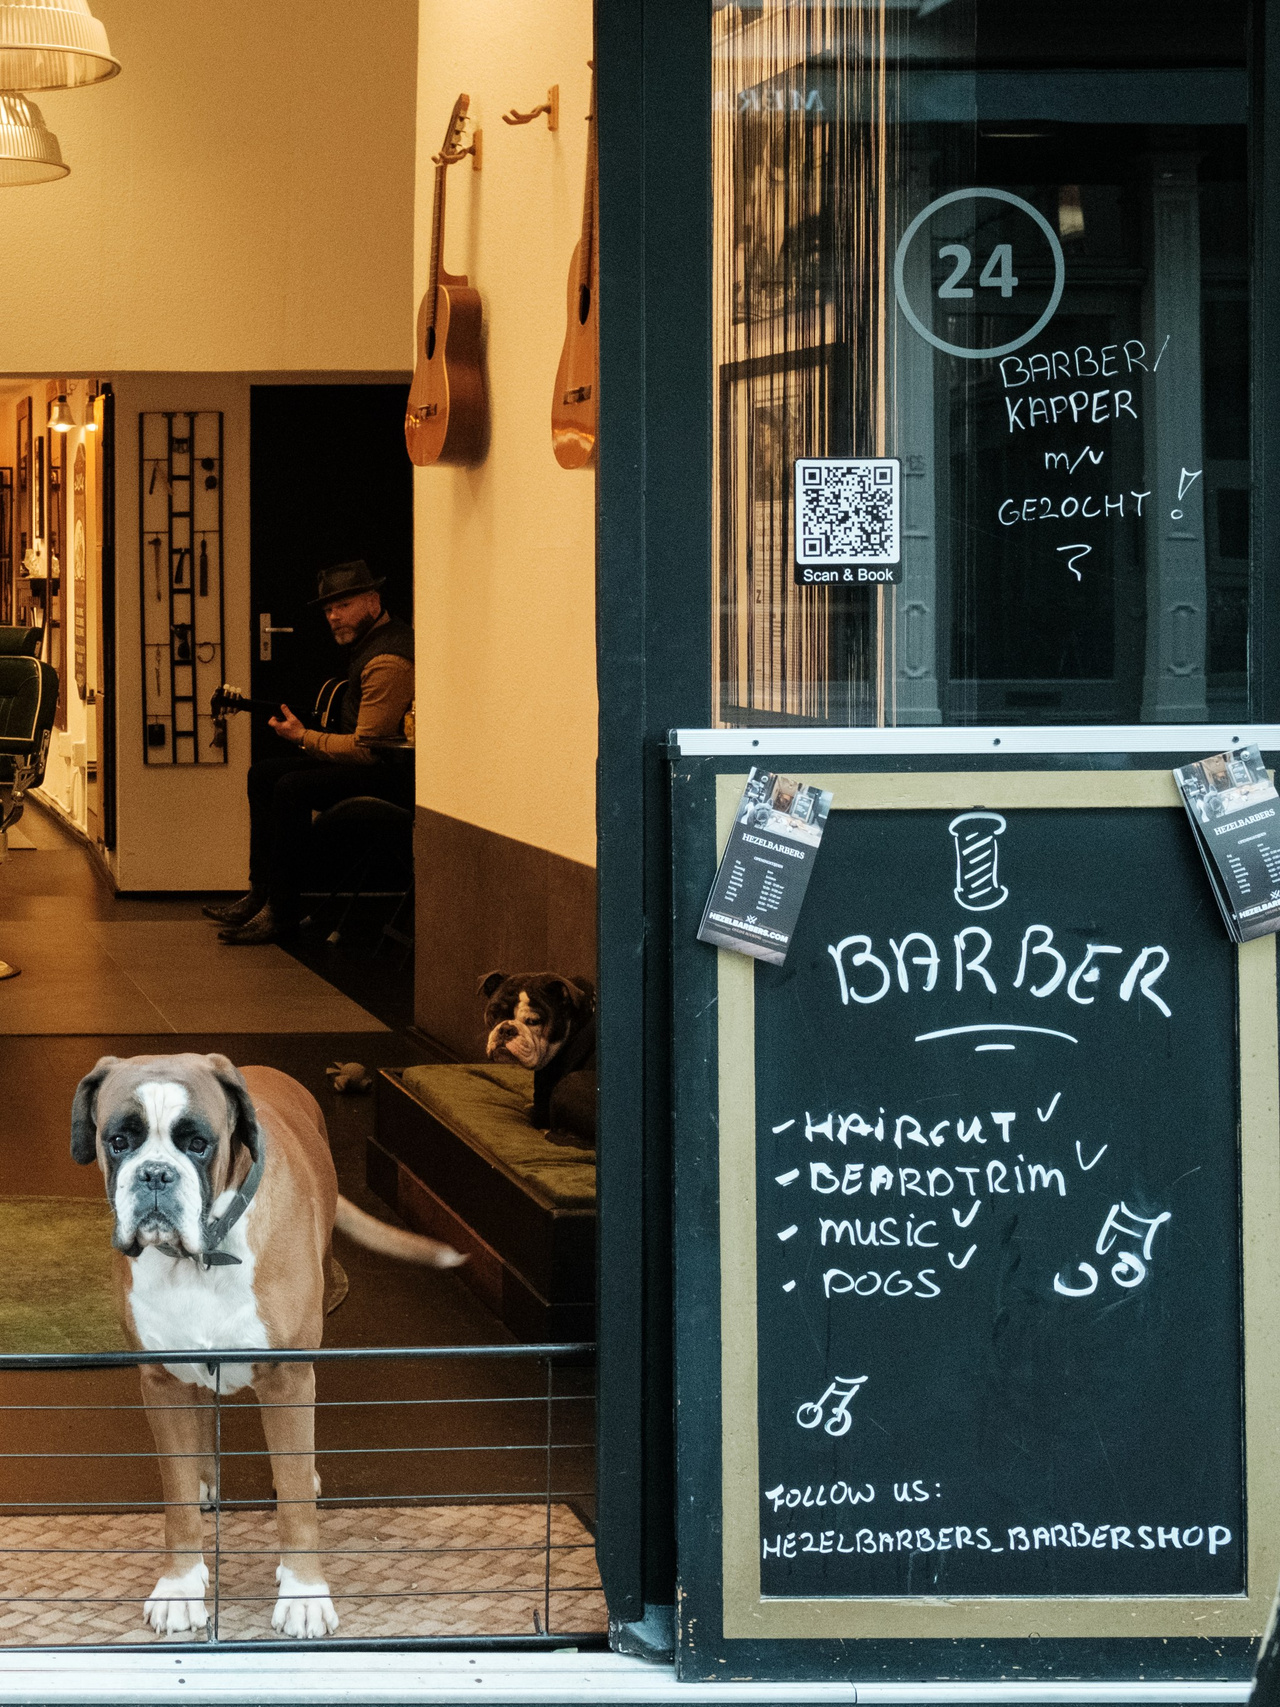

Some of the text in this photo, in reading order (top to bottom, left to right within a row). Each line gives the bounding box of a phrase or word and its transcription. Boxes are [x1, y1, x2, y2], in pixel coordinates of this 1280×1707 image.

[938, 243, 1019, 299] 24
[1005, 389, 1138, 433] KAPPER
[803, 568, 894, 582] Scan & Book
[1213, 808, 1276, 836] HEZELBARBERS
[742, 832, 806, 860] HEZELBARBERS
[709, 911, 789, 943] HEZELBARBERS.COM
[827, 924, 1173, 1018] BARBER
[822, 1267, 942, 1299] DOGS
[764, 1480, 942, 1512] FOLLOW US:
